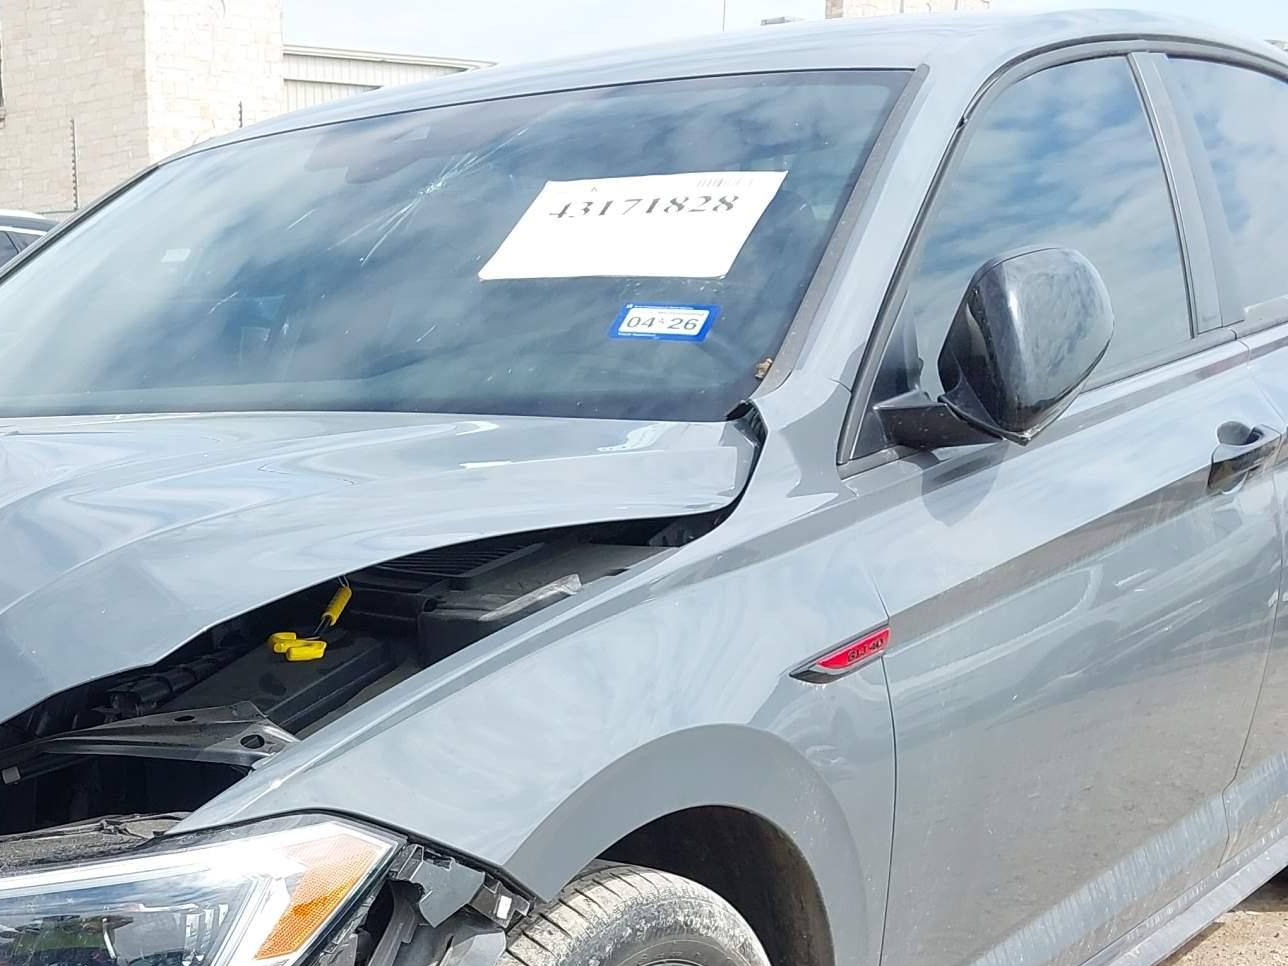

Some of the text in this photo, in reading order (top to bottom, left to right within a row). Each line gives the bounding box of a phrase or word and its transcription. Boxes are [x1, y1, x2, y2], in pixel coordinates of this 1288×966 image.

[549, 194, 740, 218] 43171828
[626, 316, 699, 330] 04 26
